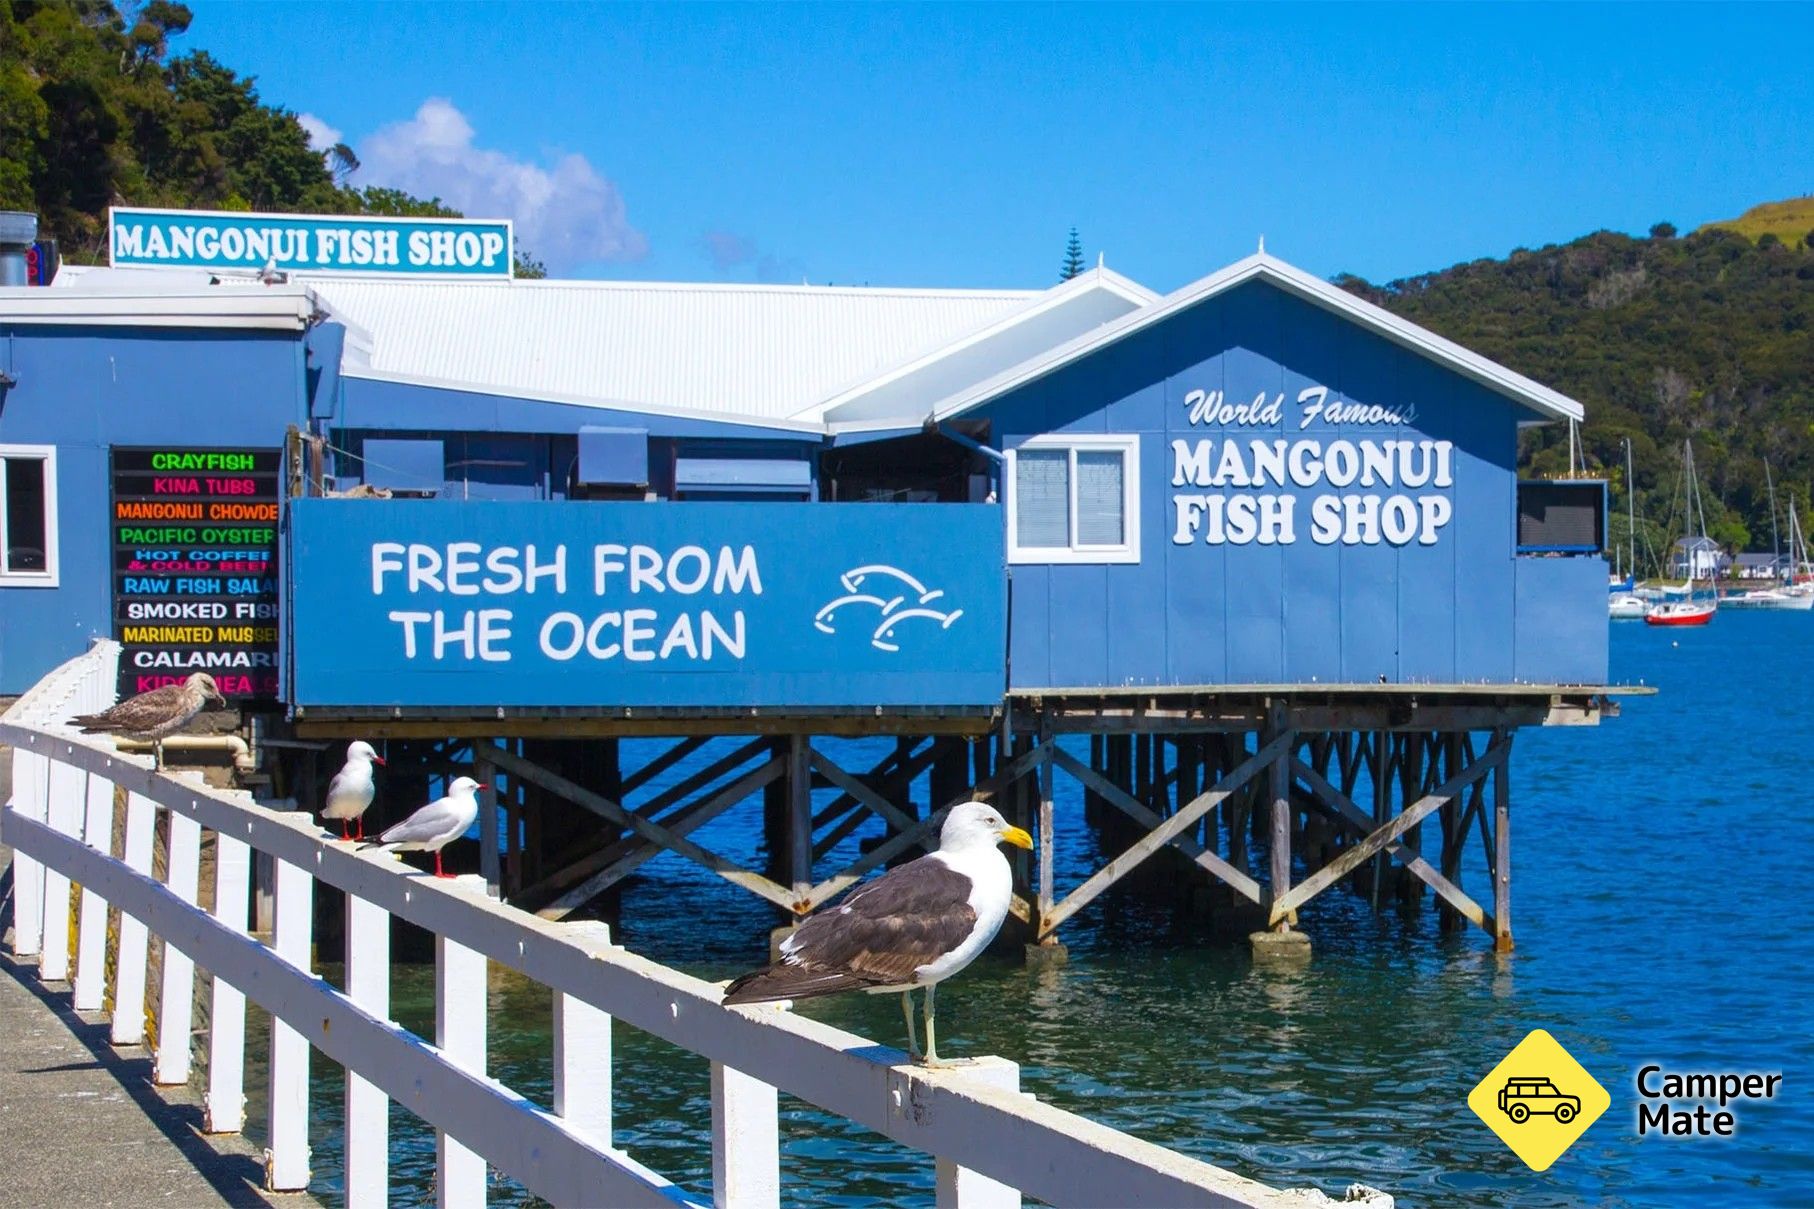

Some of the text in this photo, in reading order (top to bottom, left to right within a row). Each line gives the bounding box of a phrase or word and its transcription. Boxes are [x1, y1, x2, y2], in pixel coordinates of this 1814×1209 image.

[115, 224, 504, 267] MANGONUI FISH SHOP
[1184, 386, 1419, 429] World Famous
[152, 453, 254, 471] CRAYFISH
[1171, 439, 1452, 487] MANGONUI
[154, 478, 255, 495] KINA TUBS
[117, 503, 279, 520] MANGONUI CHOWDE
[1172, 494, 1452, 545] FISH SHOP
[120, 527, 196, 544] PACIFIC
[135, 551, 182, 561] HOT
[149, 561, 210, 571] COLD
[372, 543, 763, 596] FRESH FROM
[124, 578, 278, 595] RAW FISH SALA
[128, 603, 227, 619] SMOKED
[123, 626, 213, 643] MARINATED
[388, 609, 746, 662] THE OCEAN
[134, 651, 279, 668] CALAMARI
